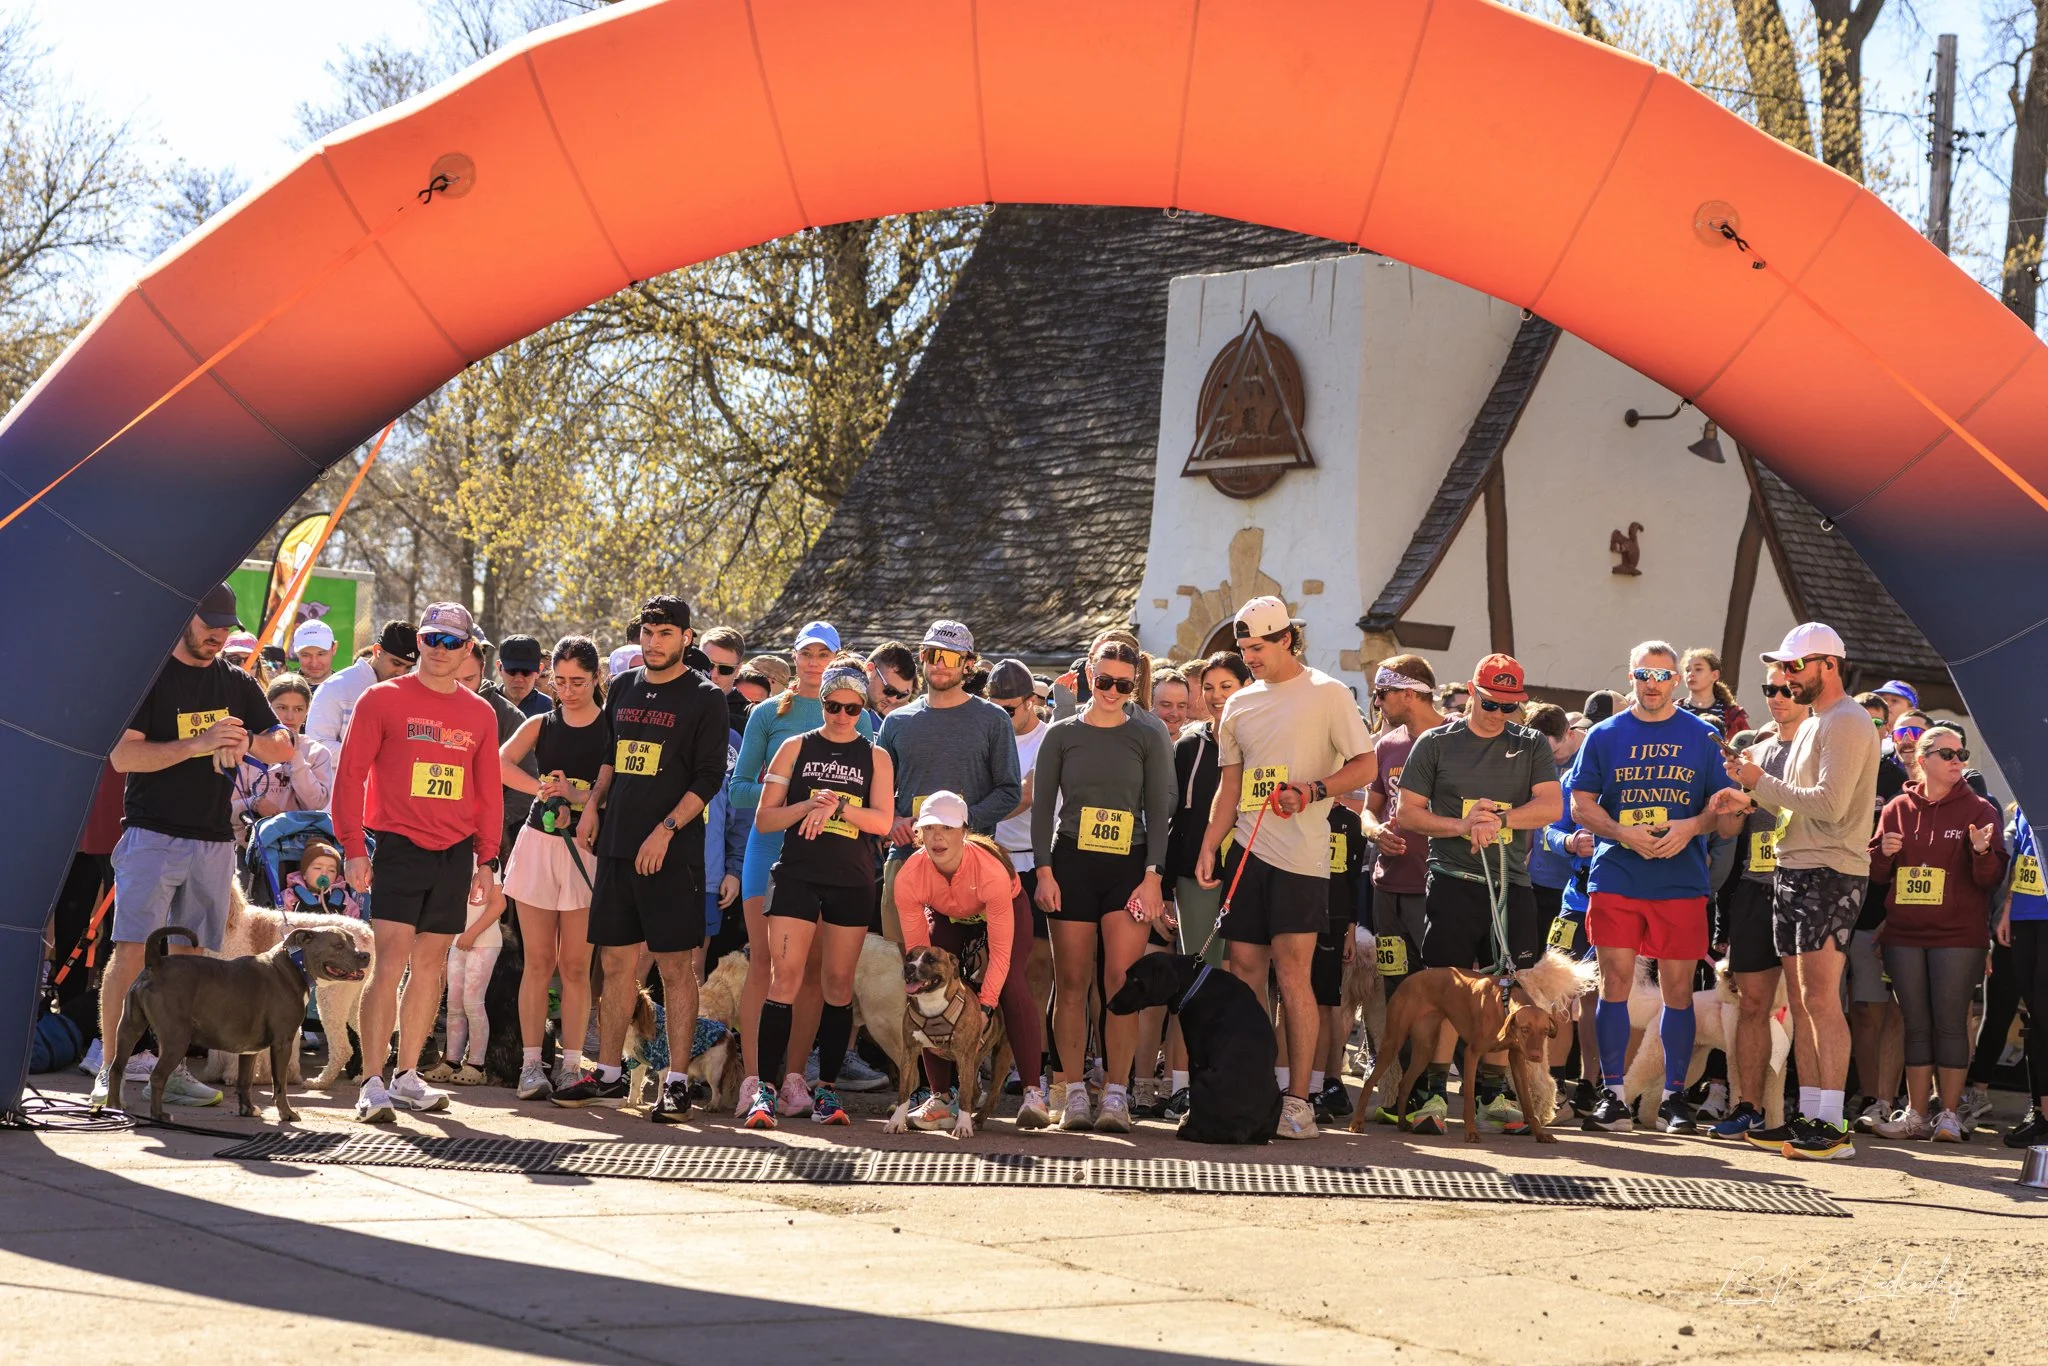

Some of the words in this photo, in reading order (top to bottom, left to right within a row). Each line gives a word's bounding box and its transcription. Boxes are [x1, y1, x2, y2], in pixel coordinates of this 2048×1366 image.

[204, 713, 216, 724] 5K
[616, 714, 640, 723] TRACK
[650, 717, 674, 728] FIELD
[617, 708, 644, 717] MINOT
[647, 710, 676, 721] STATE
[639, 743, 650, 753] 5K
[1629, 745, 1638, 759] I
[1640, 744, 1682, 760] JUST
[624, 755, 646, 772] 103
[444, 767, 454, 777] 5K
[803, 761, 864, 781] ATYPICAL
[1265, 768, 1276, 778] 5K
[1614, 766, 1655, 783] FELT
[1656, 765, 1696, 784] LIKE
[427, 779, 452, 796] 270
[1252, 781, 1275, 798] 483
[1620, 787, 1691, 805] RUNNING
[1111, 813, 1122, 822] 5K
[1645, 809, 1655, 818] 5K
[1091, 823, 1120, 841] 486
[1907, 880, 1931, 893] 390
[1382, 939, 1393, 948] 5K
